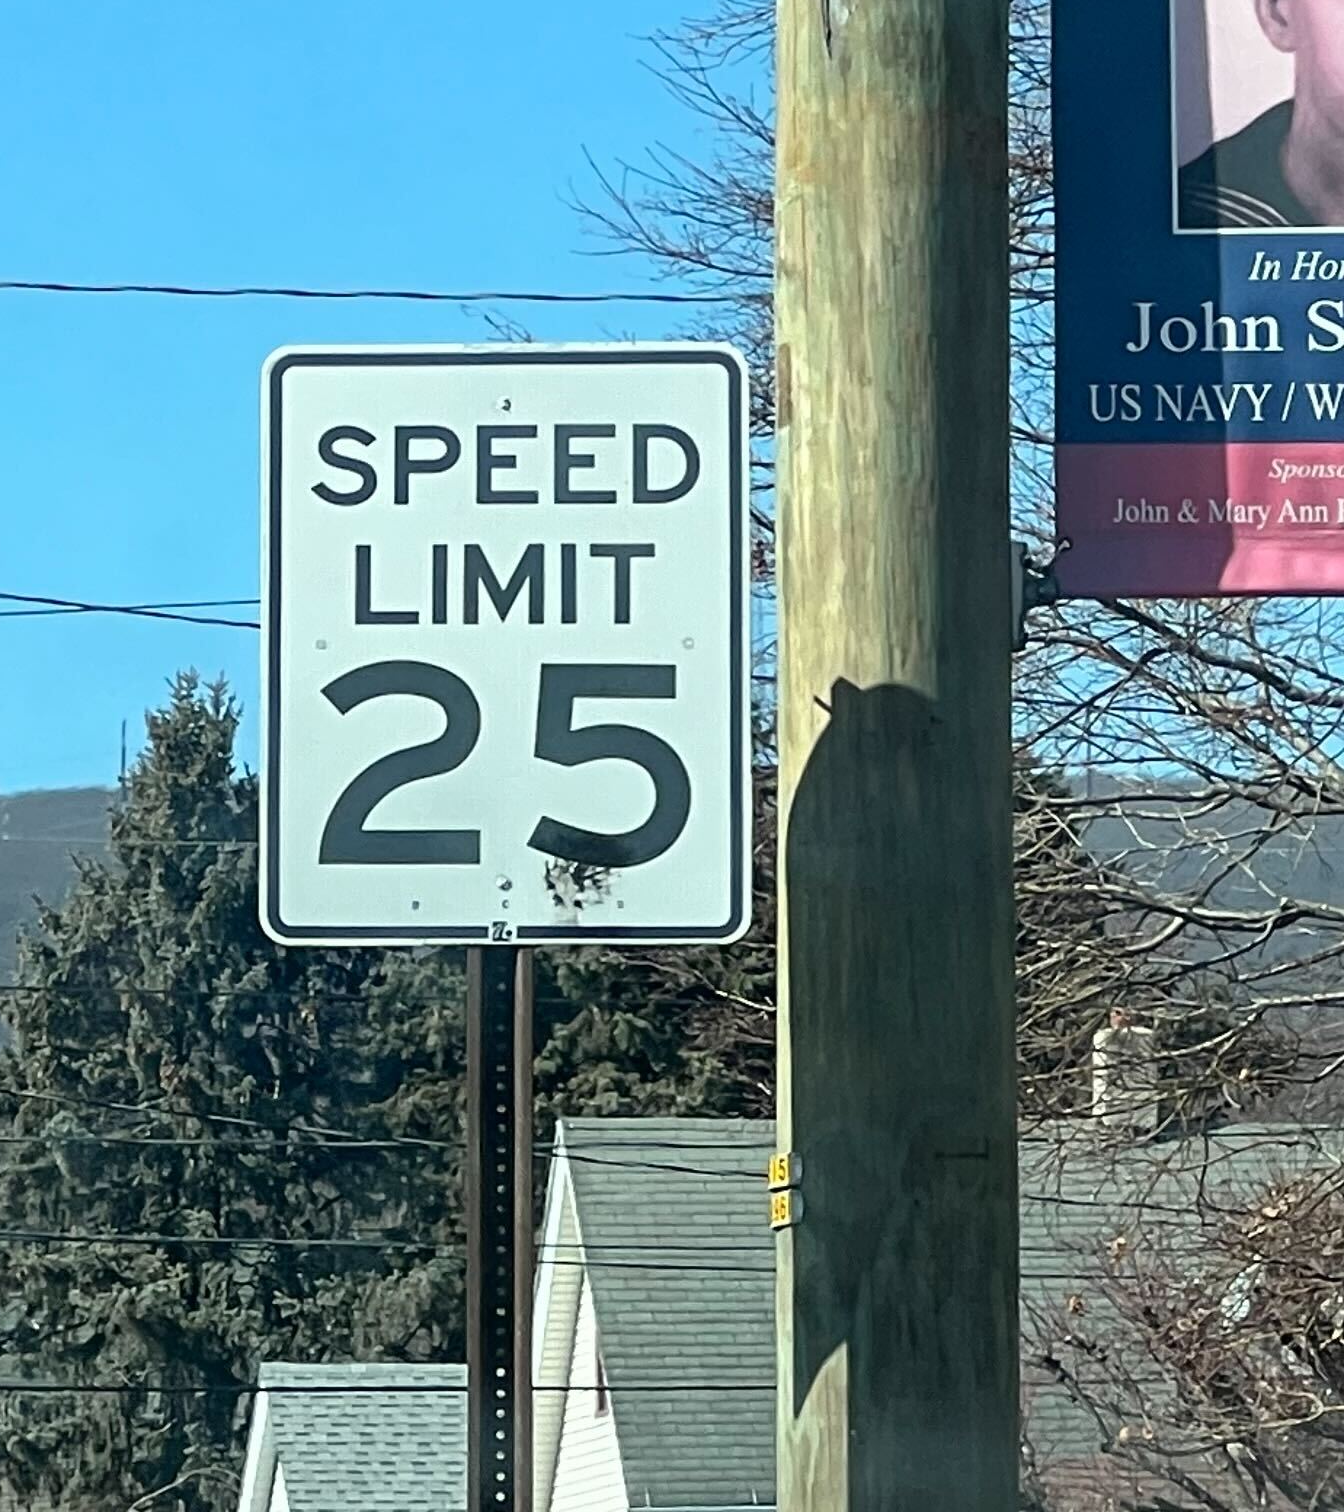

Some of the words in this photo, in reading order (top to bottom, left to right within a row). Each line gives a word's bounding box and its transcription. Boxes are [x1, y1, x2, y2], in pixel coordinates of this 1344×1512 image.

[1249, 252, 1280, 281] In
[1125, 301, 1284, 353] John
[1089, 384, 1142, 421] US
[1155, 384, 1271, 421] NAVY
[1282, 384, 1295, 421] /
[311, 423, 700, 506] SPEED
[1113, 497, 1169, 523] John
[1177, 499, 1198, 523] &
[1208, 498, 1270, 528] Mary
[1278, 499, 1328, 523] Ann
[356, 543, 655, 625] LIMIT
[318, 660, 692, 867] 25
